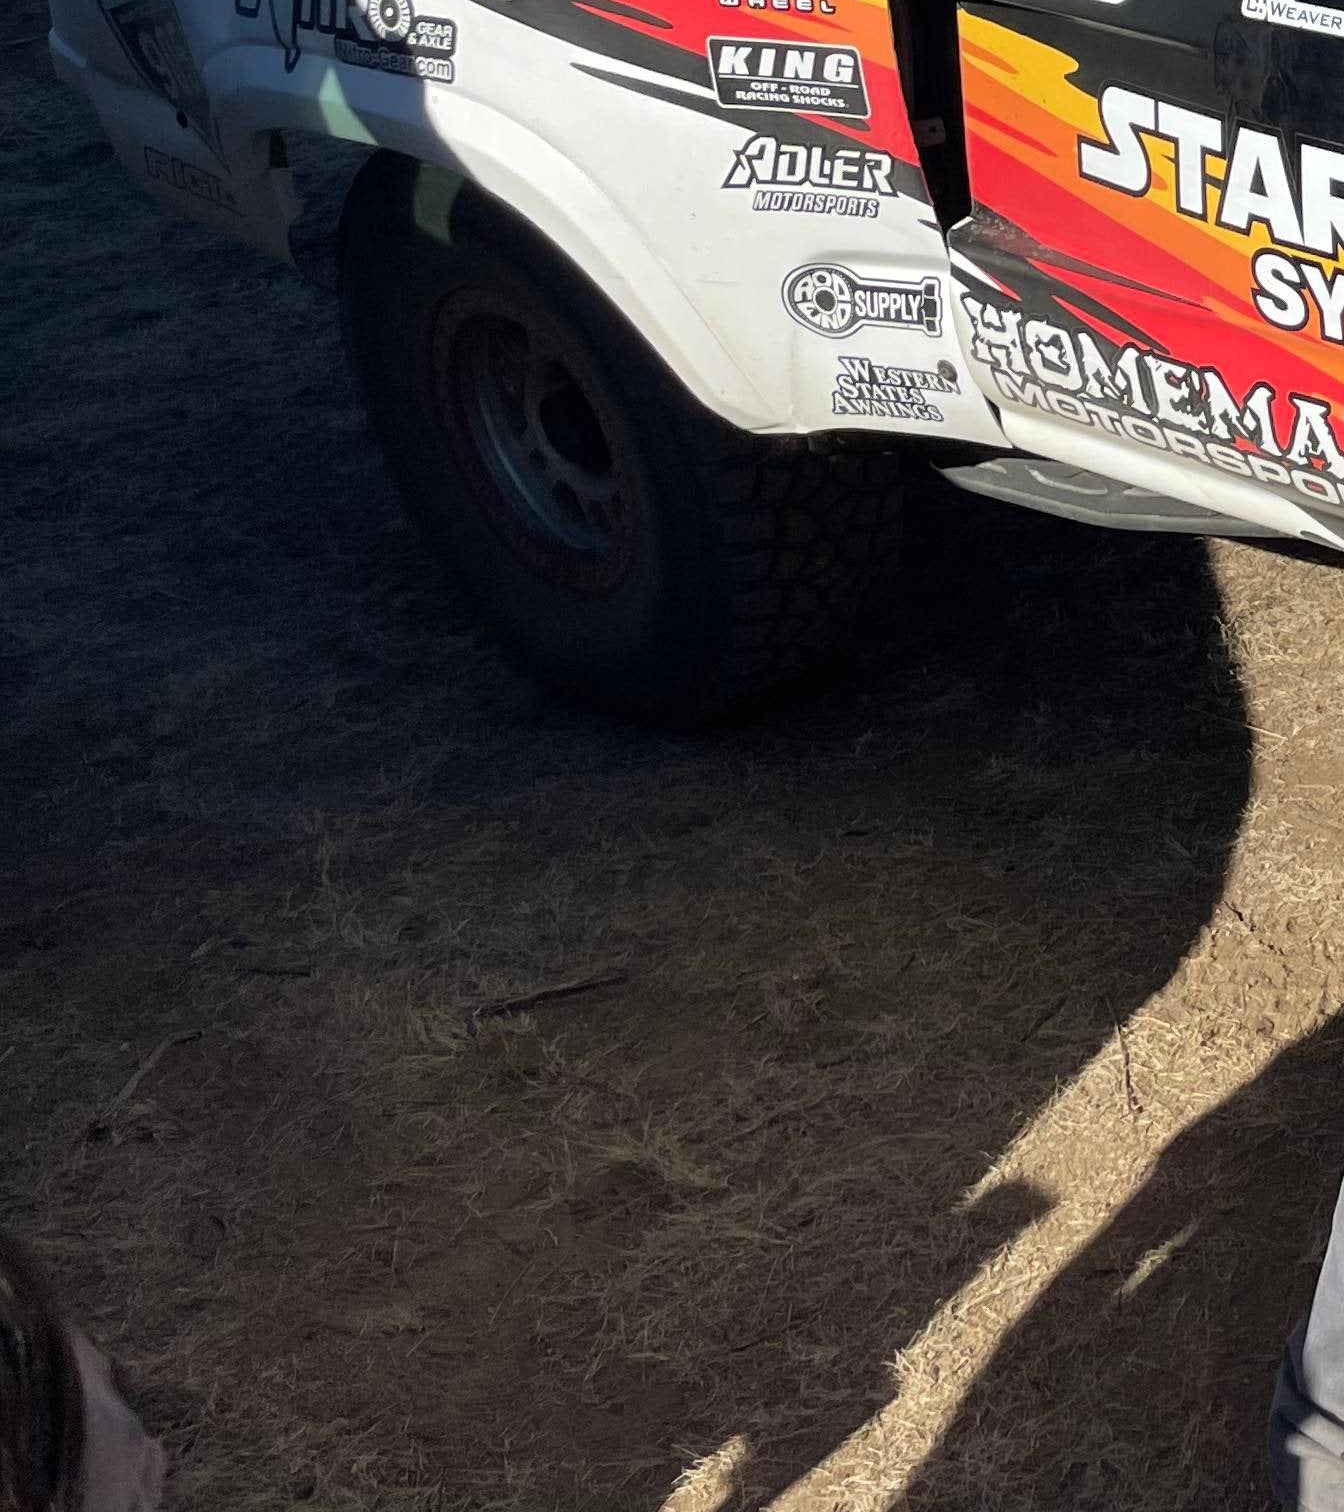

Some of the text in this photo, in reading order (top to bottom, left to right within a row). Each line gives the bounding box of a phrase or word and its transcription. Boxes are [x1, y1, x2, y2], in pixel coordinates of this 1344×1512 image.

[417, 21, 453, 38] GEAR
[1270, 1, 1343, 30] WEAVER
[418, 35, 453, 51] AXLE
[718, 45, 855, 83] KING
[736, 90, 846, 108] RACING SHOCKS
[721, 134, 900, 197] ADLER
[752, 190, 880, 218] MOTORSPORTS
[854, 290, 922, 322] SUPPLY
[836, 374, 925, 405] STATES
[838, 356, 961, 395] WESTERN
[832, 390, 944, 422] AWNINGS
